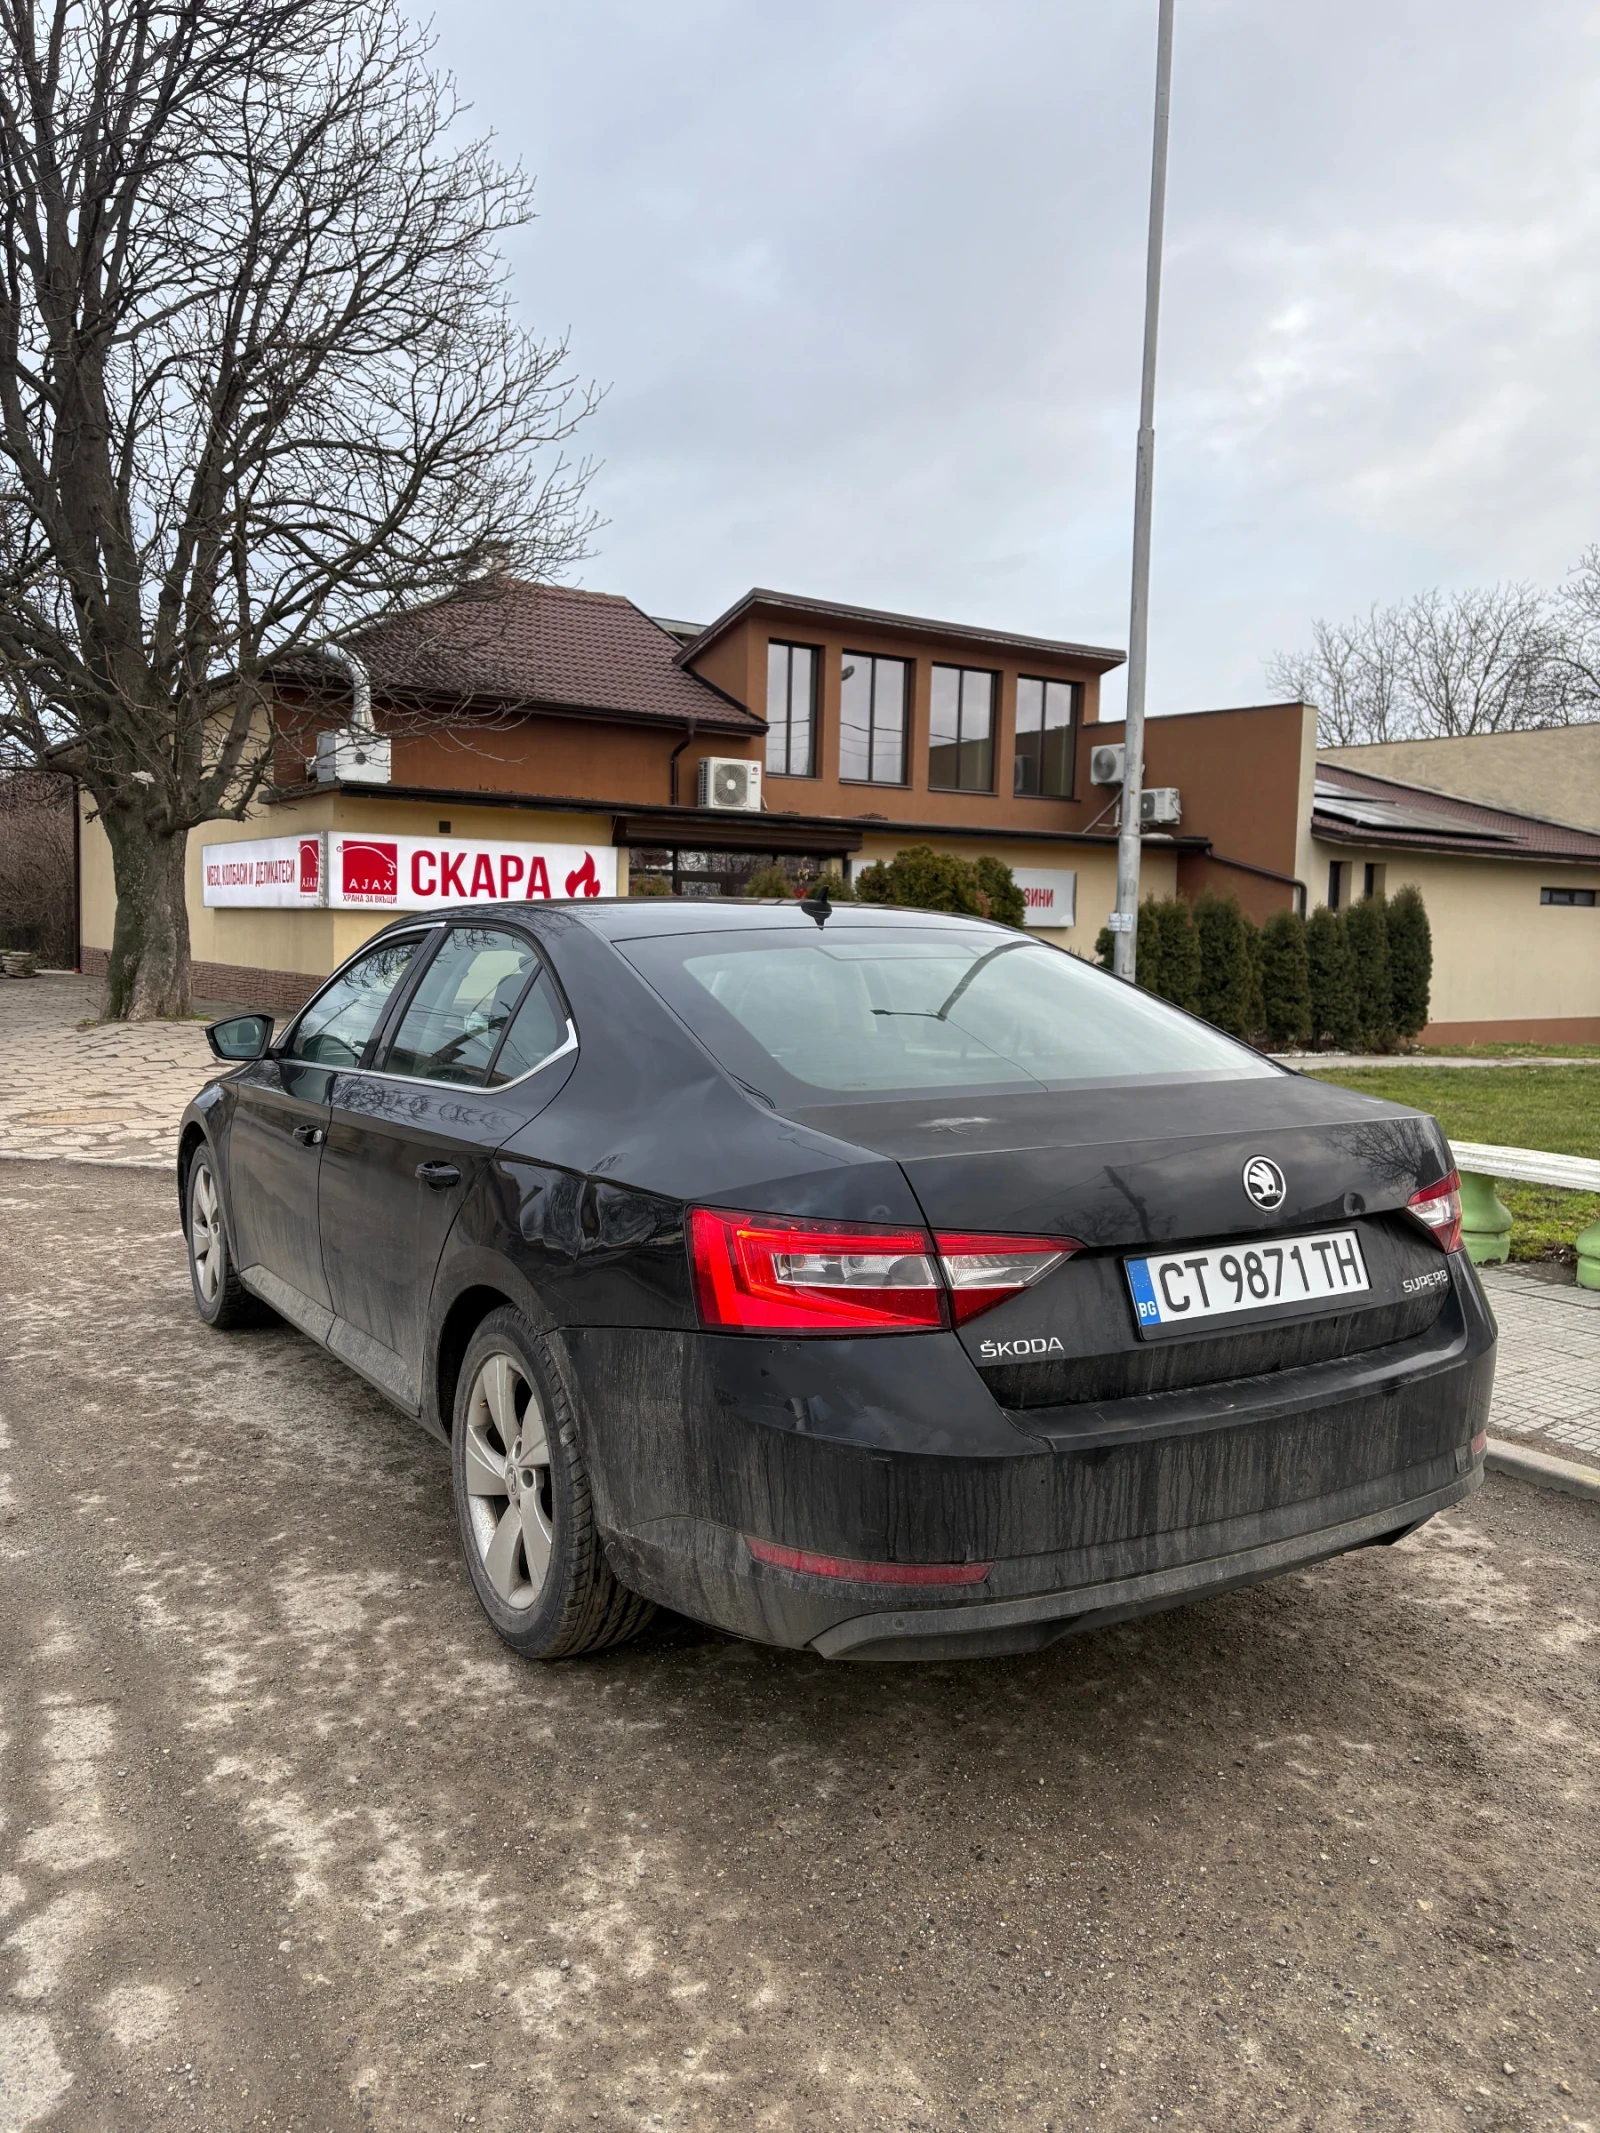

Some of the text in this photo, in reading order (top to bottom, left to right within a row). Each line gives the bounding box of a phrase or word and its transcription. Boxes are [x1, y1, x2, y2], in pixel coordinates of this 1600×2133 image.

[222, 863, 248, 886] КОЛБАСИ
[249, 862, 254, 884] И
[255, 859, 295, 887] ДЕЛИКАТЕСИ
[301, 877, 318, 888] AJAX
[411, 850, 552, 899] СКАРА
[349, 878, 392, 891] AJAX
[342, 894, 398, 904] ХРАНА ЗА ВКЪЩИ
[1023, 888, 1054, 908] ЗИНИ
[1159, 1238, 1361, 1312] CT 9871 TH
[1403, 1270, 1448, 1293] SUPERB
[1138, 1300, 1157, 1318] BG
[980, 1337, 1064, 1358] ŠKODA
